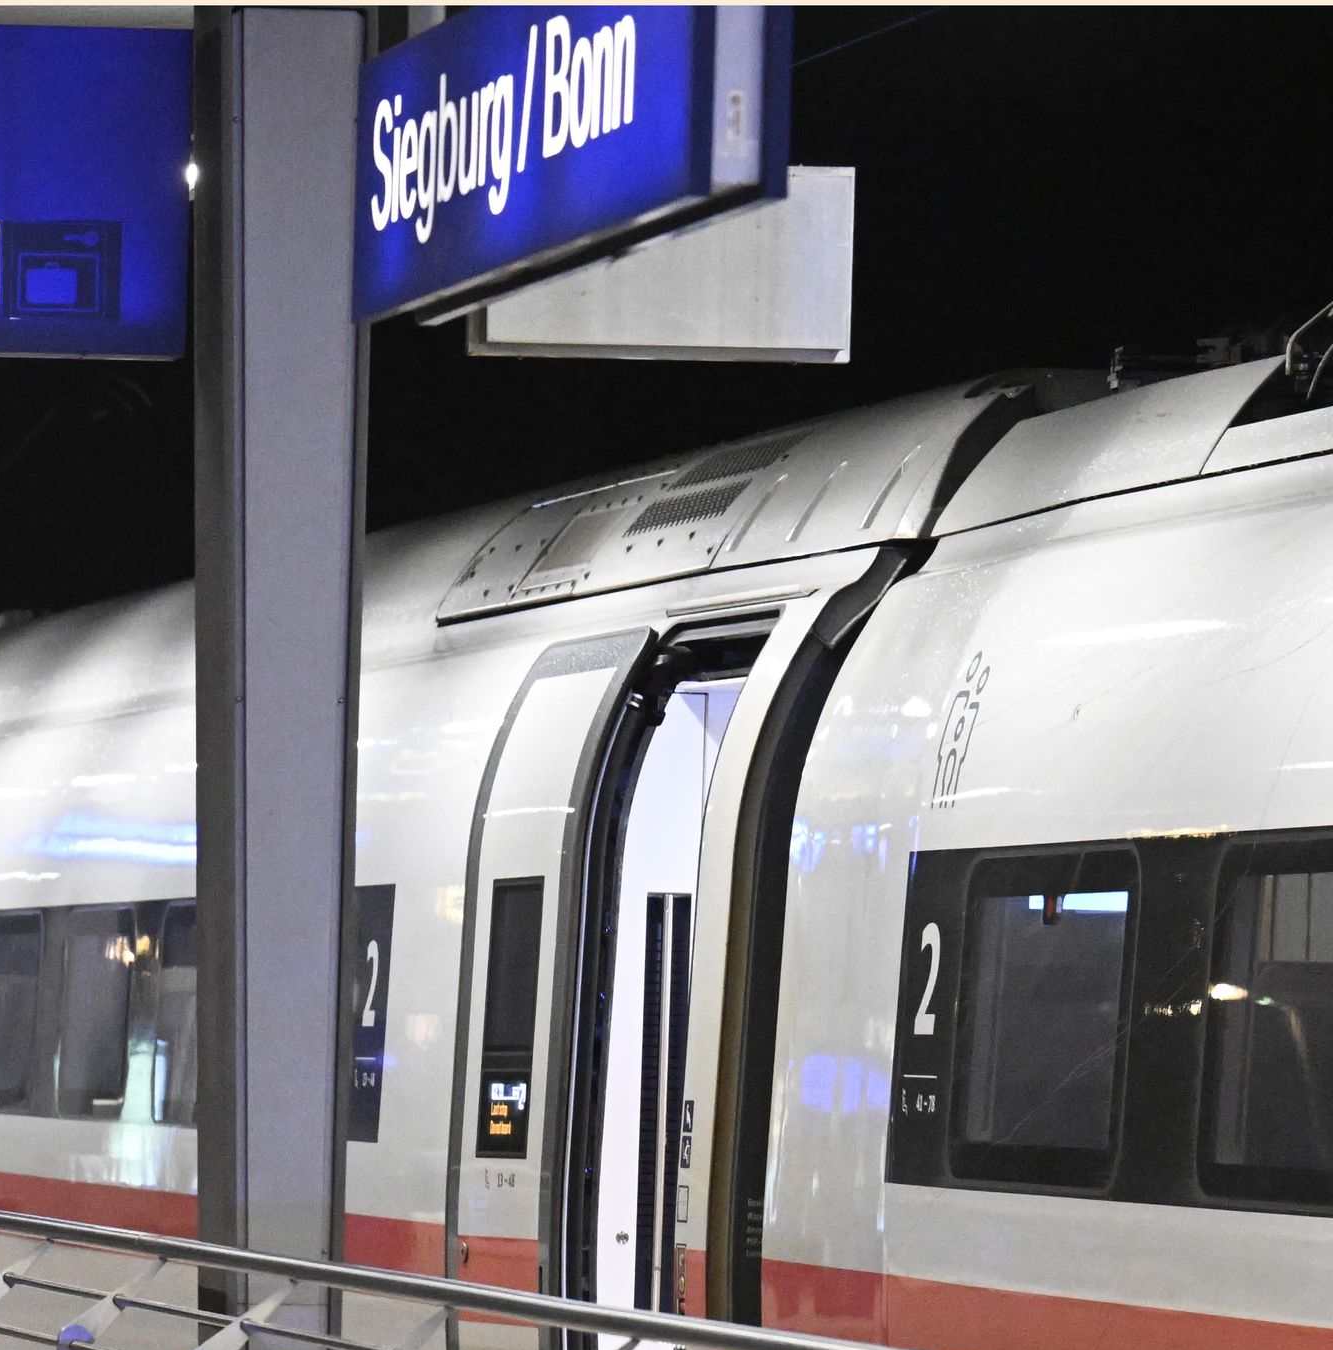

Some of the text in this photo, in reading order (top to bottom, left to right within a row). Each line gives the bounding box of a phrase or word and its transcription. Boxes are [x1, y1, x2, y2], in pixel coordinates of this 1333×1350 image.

[370, 73, 514, 244] Siegburg
[542, 14, 636, 158] Bonn
[361, 939, 380, 1028] 2
[913, 922, 941, 1036] 2
